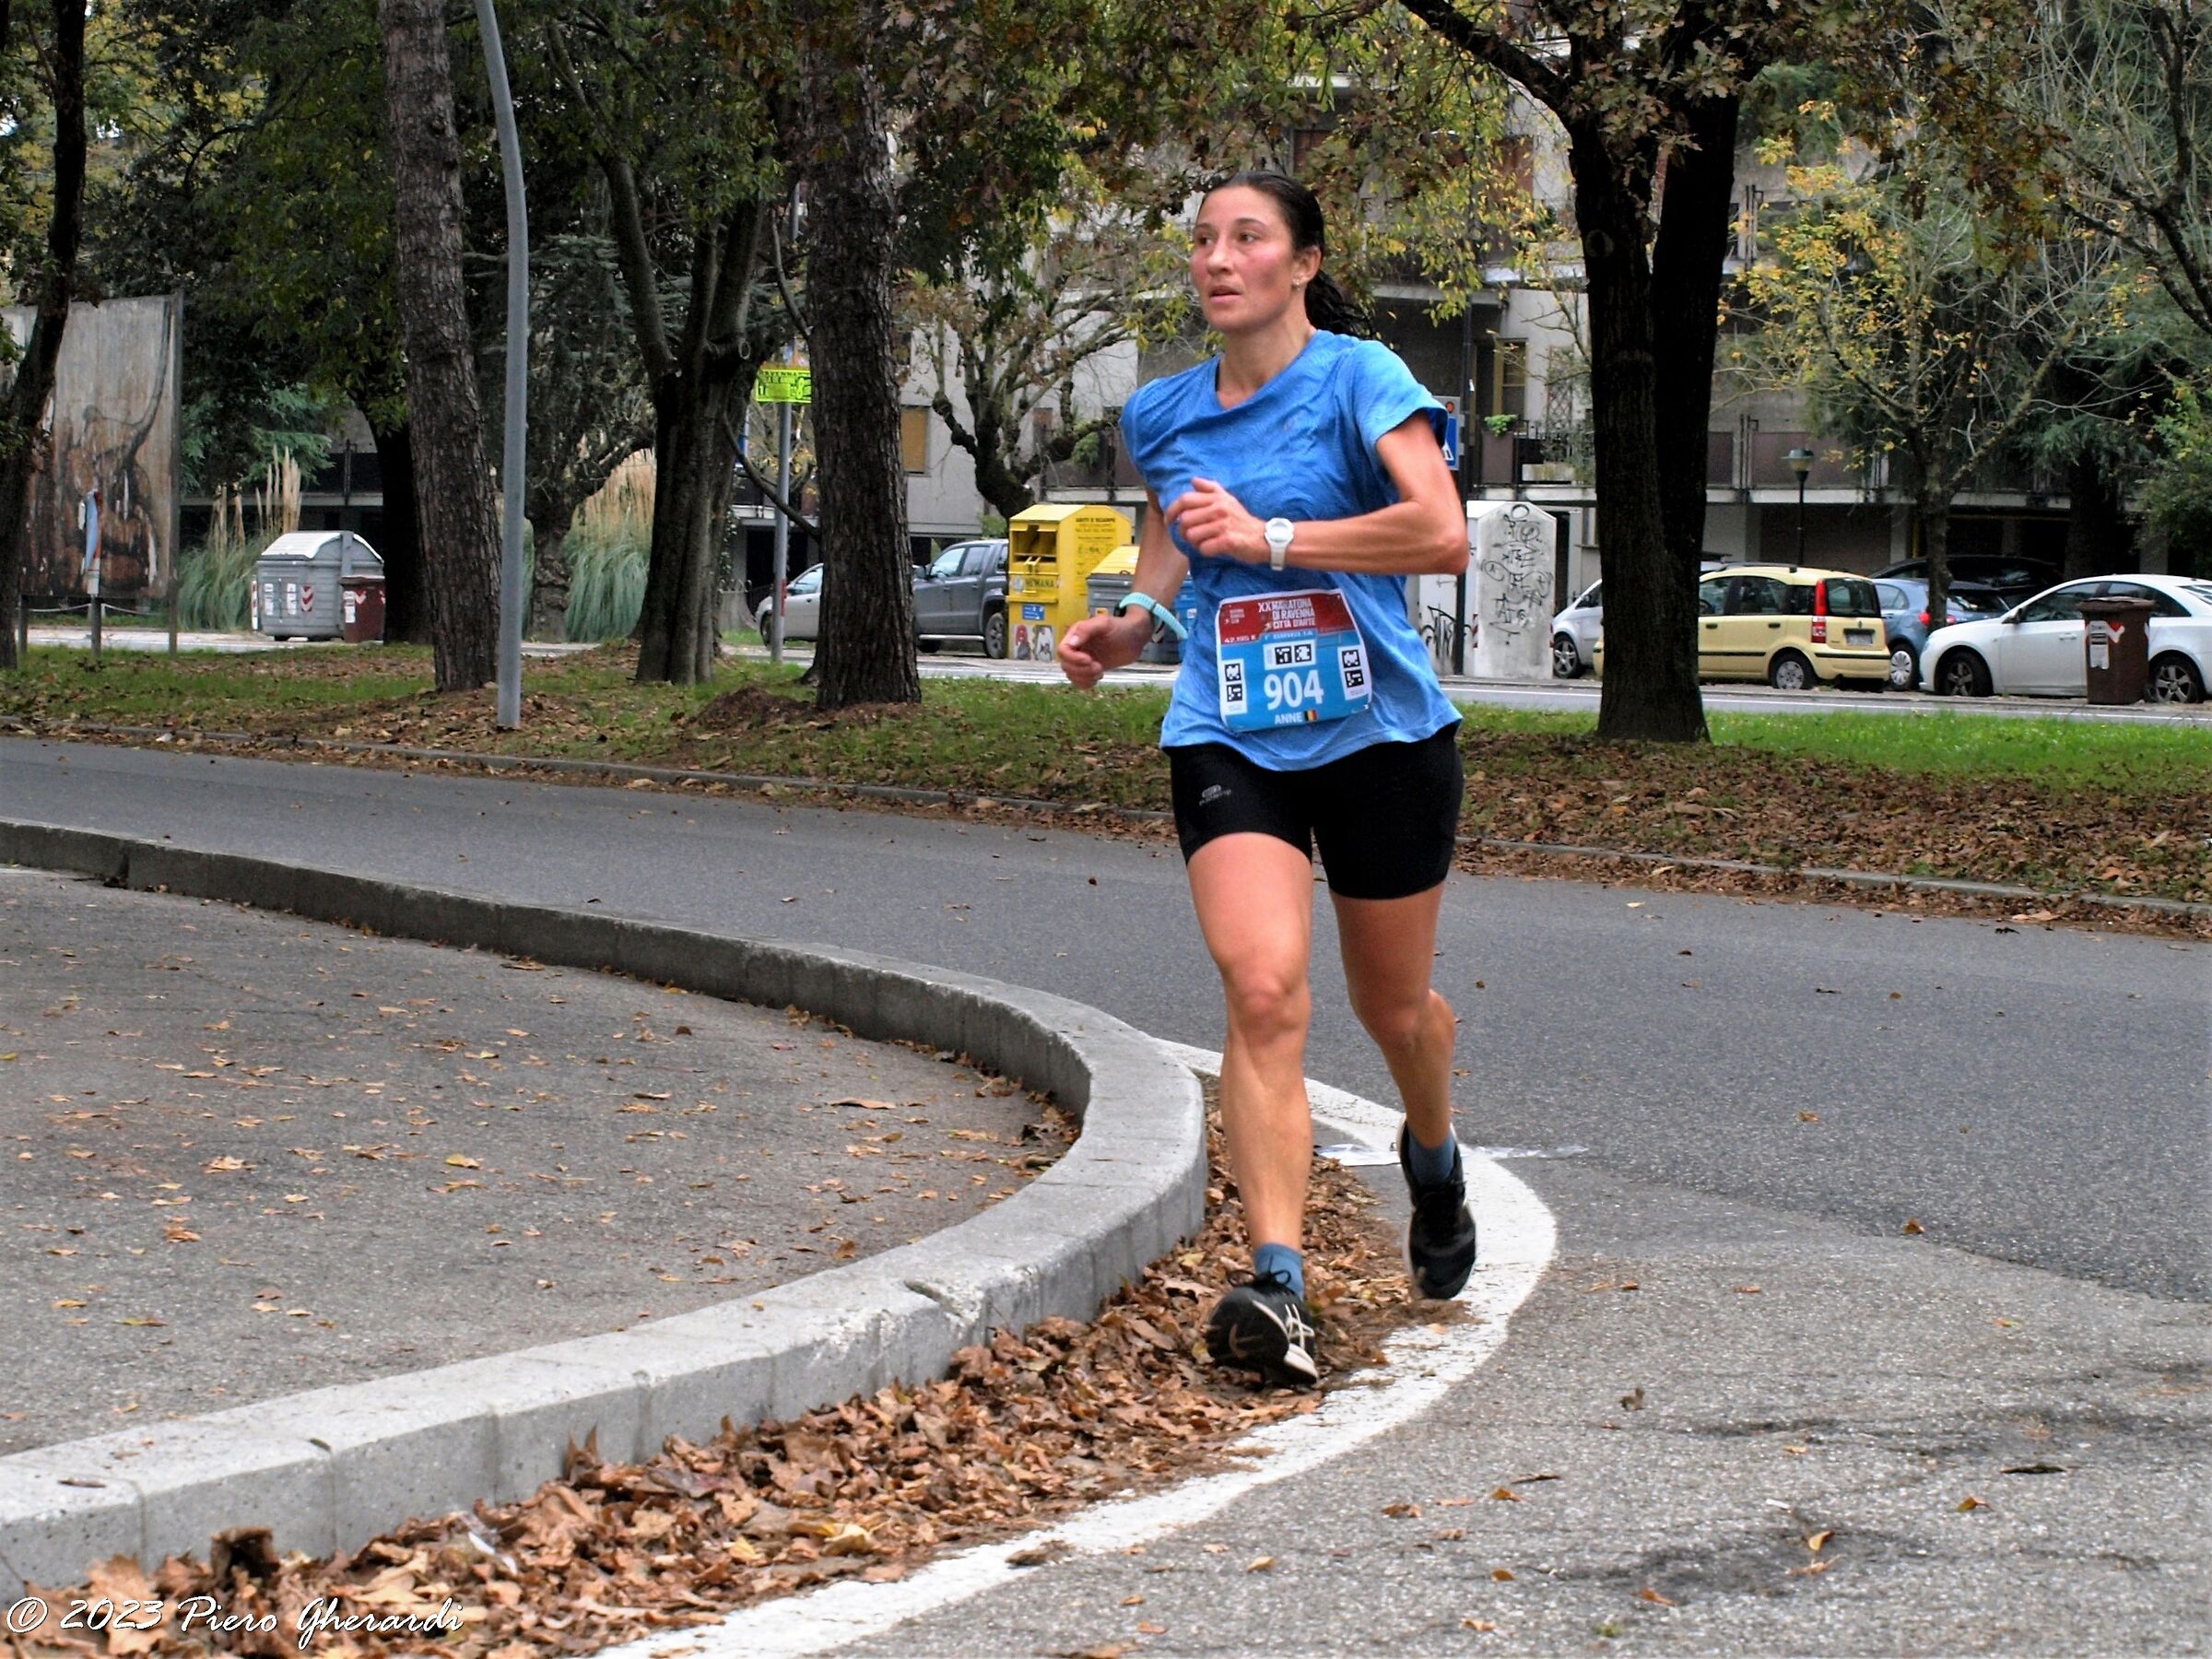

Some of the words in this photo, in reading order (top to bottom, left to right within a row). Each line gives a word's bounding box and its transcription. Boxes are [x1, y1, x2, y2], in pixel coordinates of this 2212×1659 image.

[1258, 602, 1272, 613] XX
[1281, 607, 1315, 620] RAVENNA
[1264, 670, 1324, 711] 904
[1275, 712, 1303, 725] ANNE
